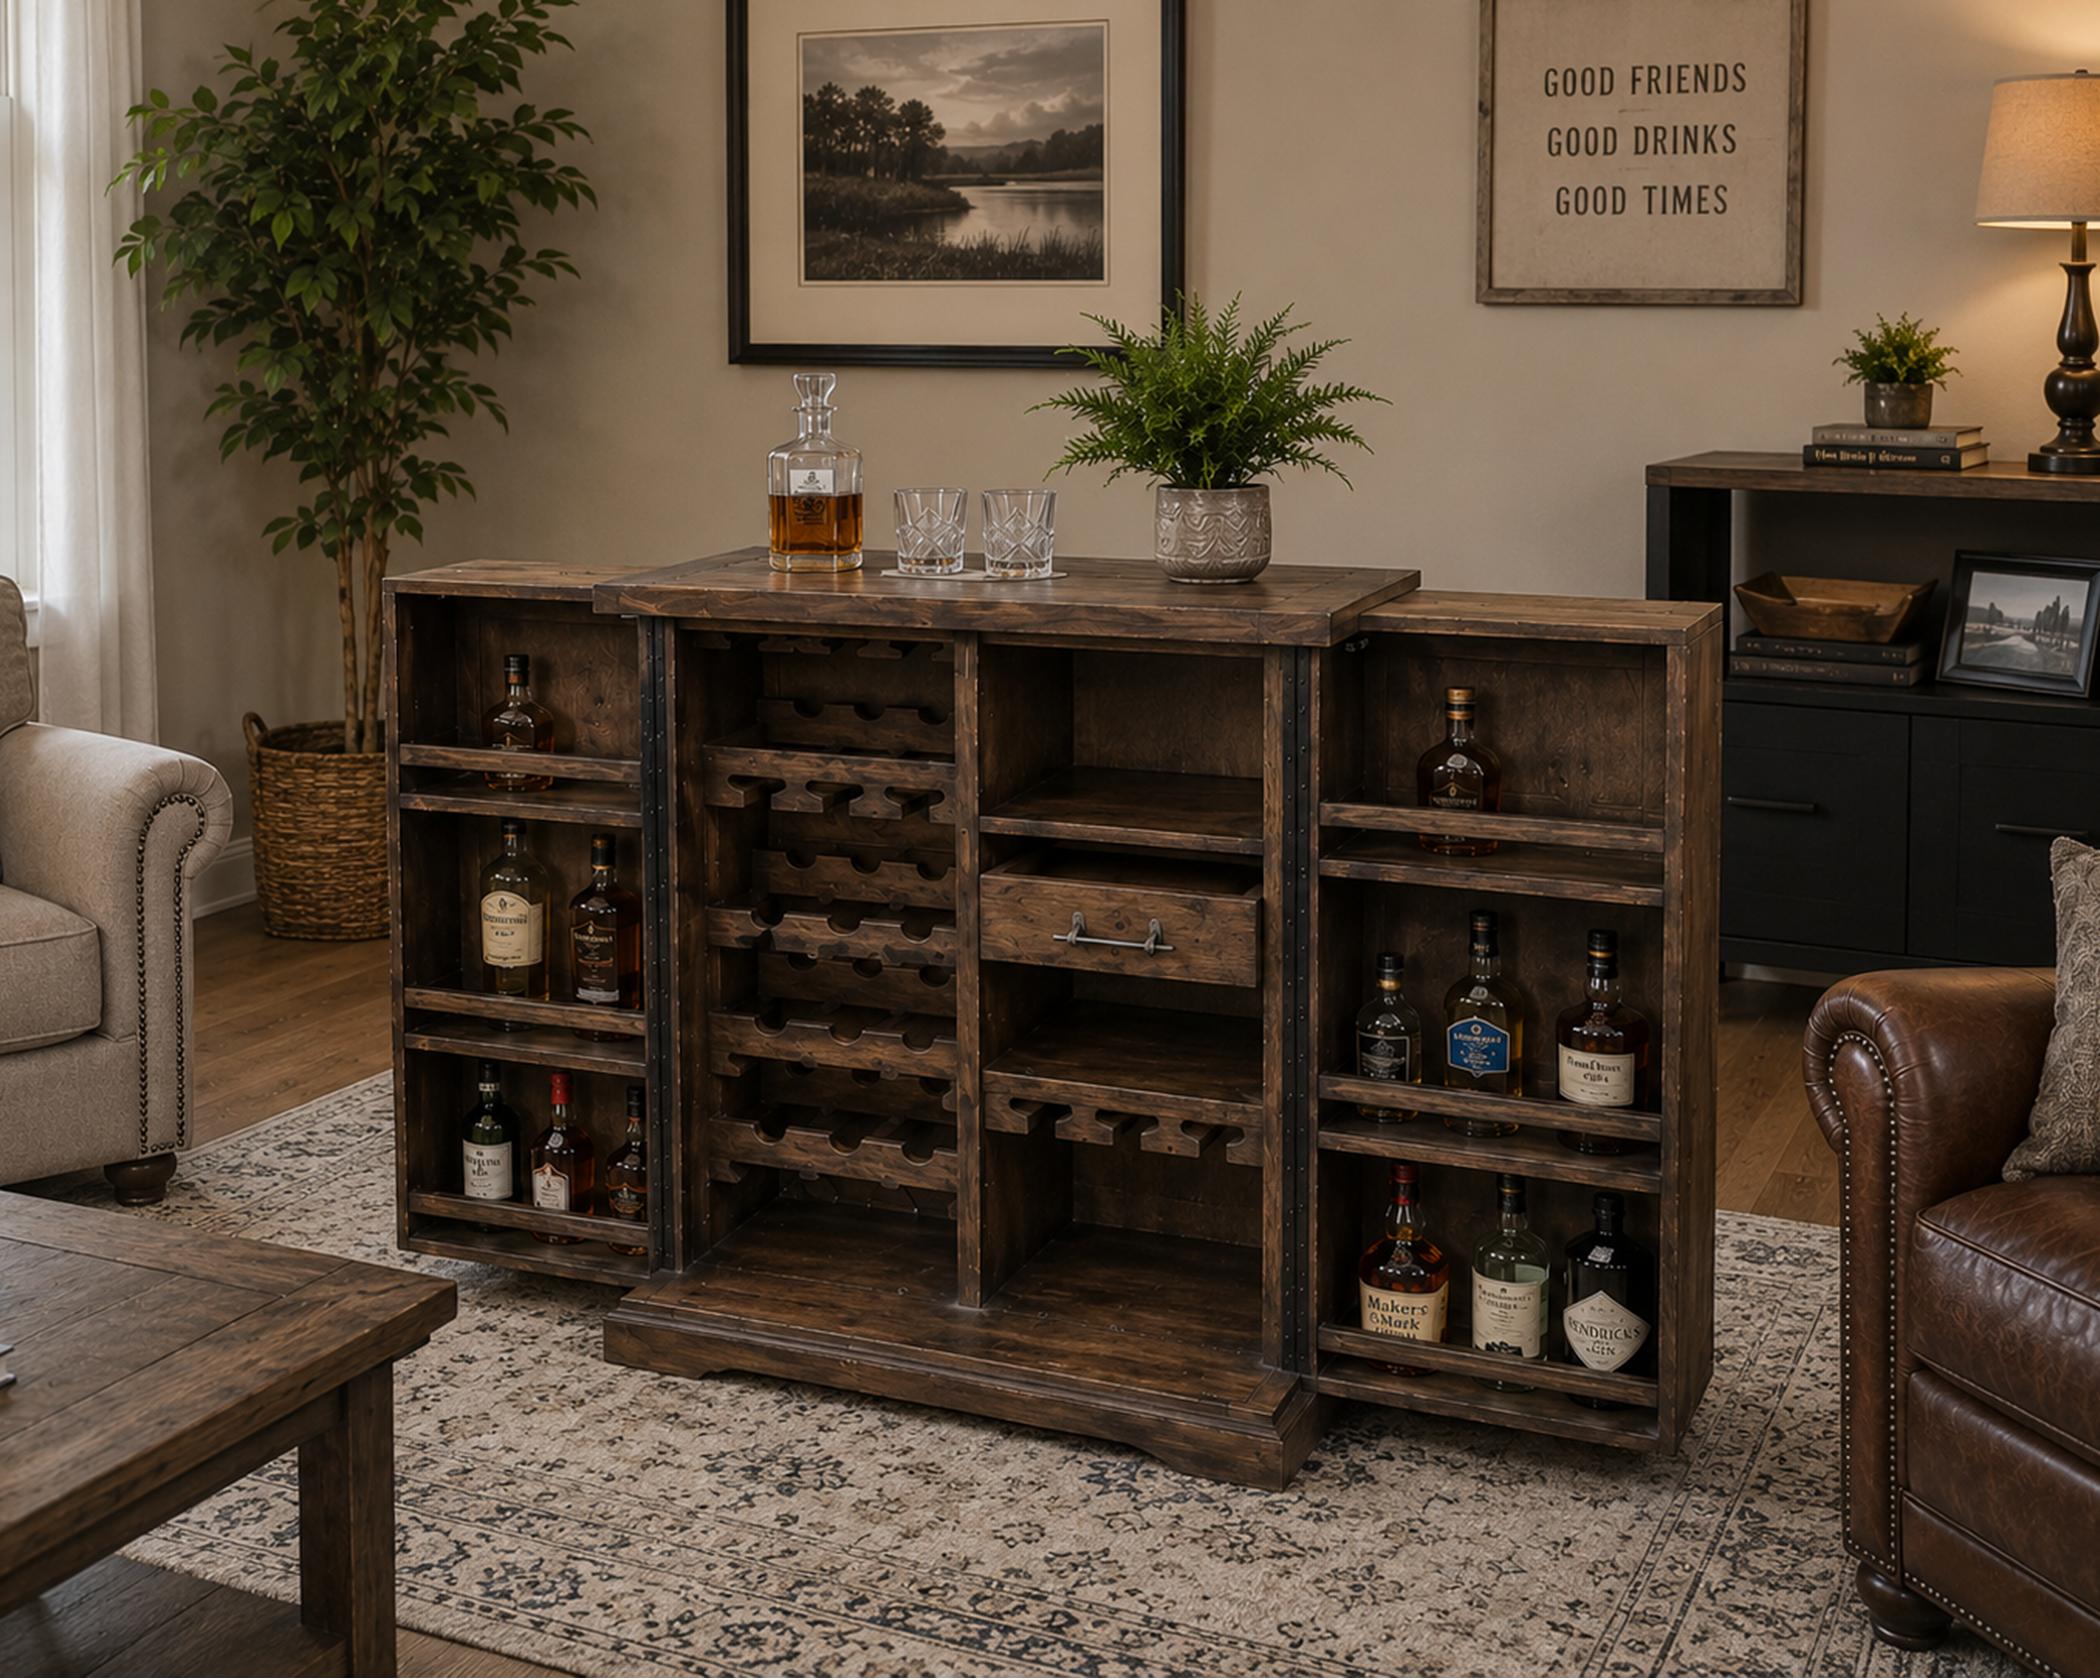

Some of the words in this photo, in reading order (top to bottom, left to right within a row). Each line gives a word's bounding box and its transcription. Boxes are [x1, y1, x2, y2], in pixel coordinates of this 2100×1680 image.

[1544, 66, 1615, 97] GOOD
[1631, 62, 1747, 95] FRIENDS
[1547, 126, 1618, 157] GOOD
[1633, 123, 1737, 155] DRINKS
[1556, 185, 1627, 216] GOOD
[1642, 184, 1728, 215] TIMES
